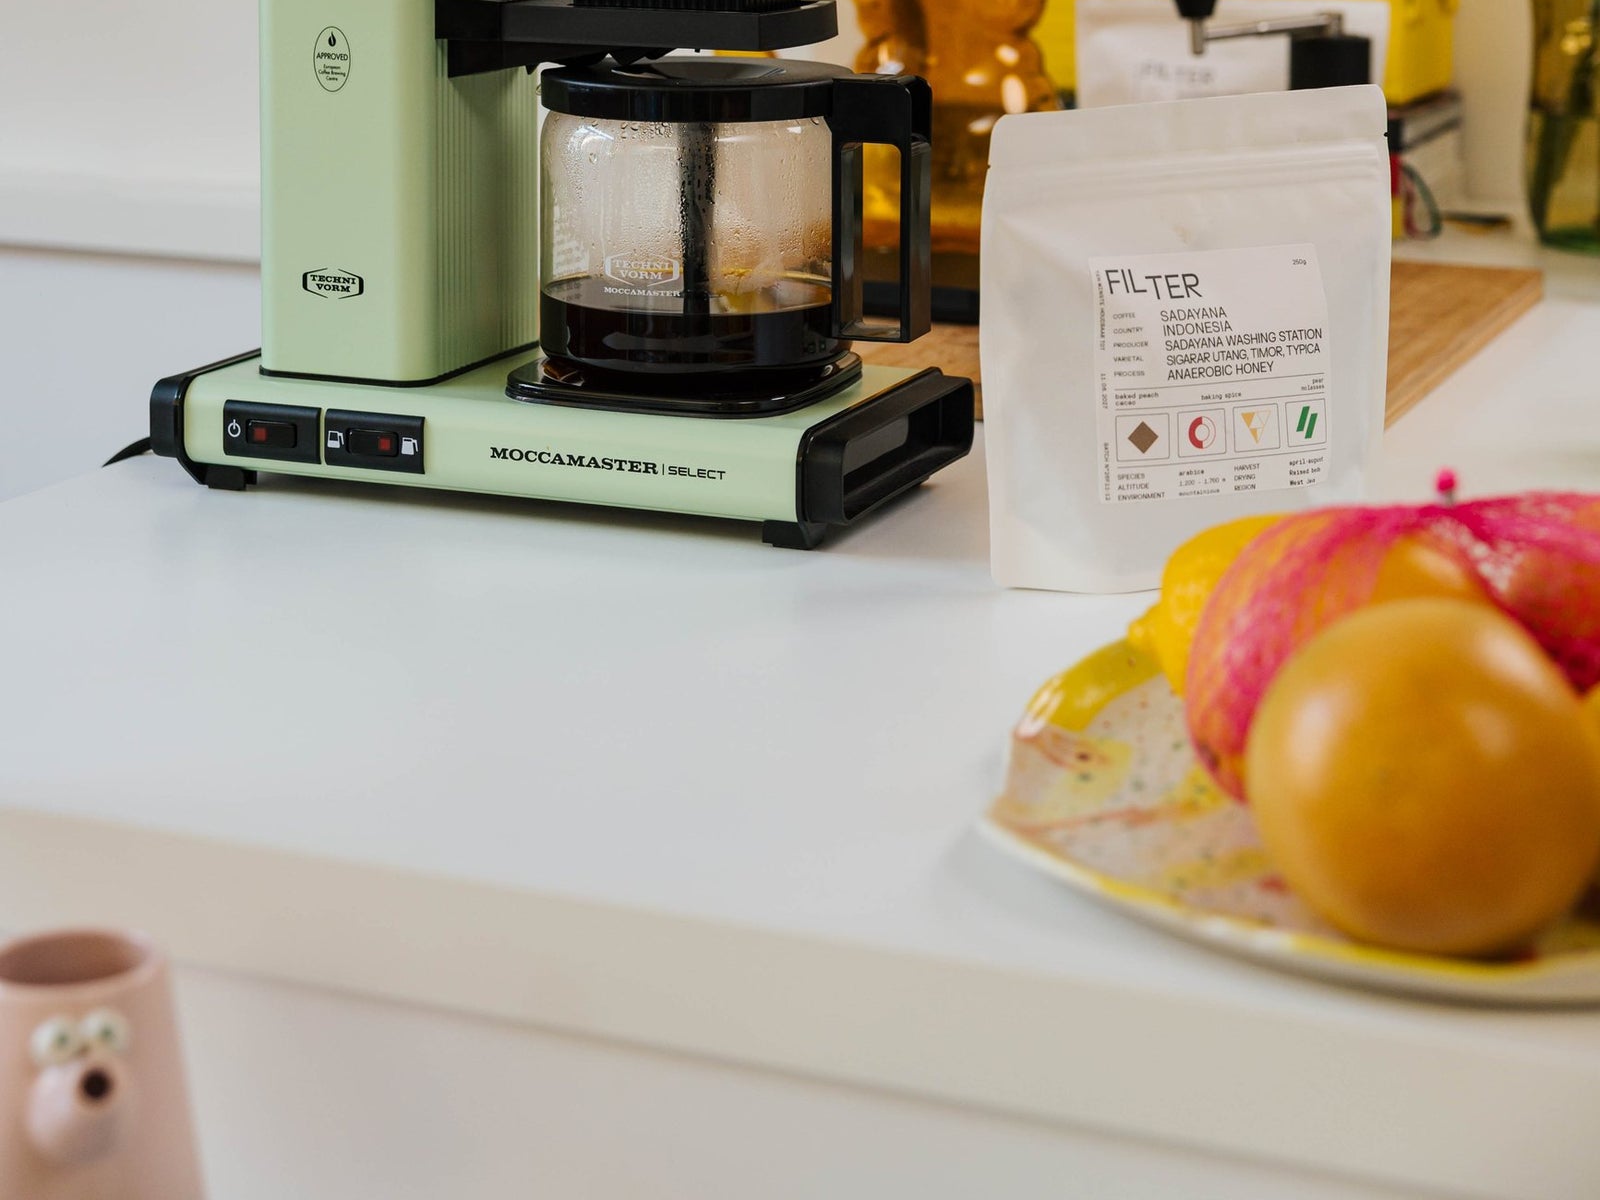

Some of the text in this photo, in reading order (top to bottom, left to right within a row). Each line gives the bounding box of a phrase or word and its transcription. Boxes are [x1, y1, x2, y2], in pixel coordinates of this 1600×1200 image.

[316, 52, 348, 61] APPROVED
[613, 260, 670, 270] TECHNI
[1292, 258, 1307, 266] 250g
[310, 274, 356, 285] TECHNI
[620, 269, 662, 280] VORM
[316, 283, 350, 293] VORM
[1105, 269, 1203, 300] FILTER
[603, 286, 681, 297] MOCCAMASTER
[1113, 312, 1135, 320] COFFEE
[1160, 306, 1227, 322] SADAYANA
[1163, 320, 1232, 337] INDONESIA
[1165, 328, 1322, 351] SADAYANA WASHING STATION
[1166, 343, 1320, 366] SIGARAR UTANG, TIMOR, TYPICA
[1167, 361, 1274, 380] ANAEROBIC HONEY
[489, 447, 726, 480] MOCCAMASTER SELECT
[1234, 463, 1260, 471] HARVEST
[1117, 473, 1145, 481] SPECIES
[1179, 469, 1204, 477] arabica
[1117, 482, 1149, 490] ALTITUDE
[1117, 492, 1165, 501] ENVIRONMENT
